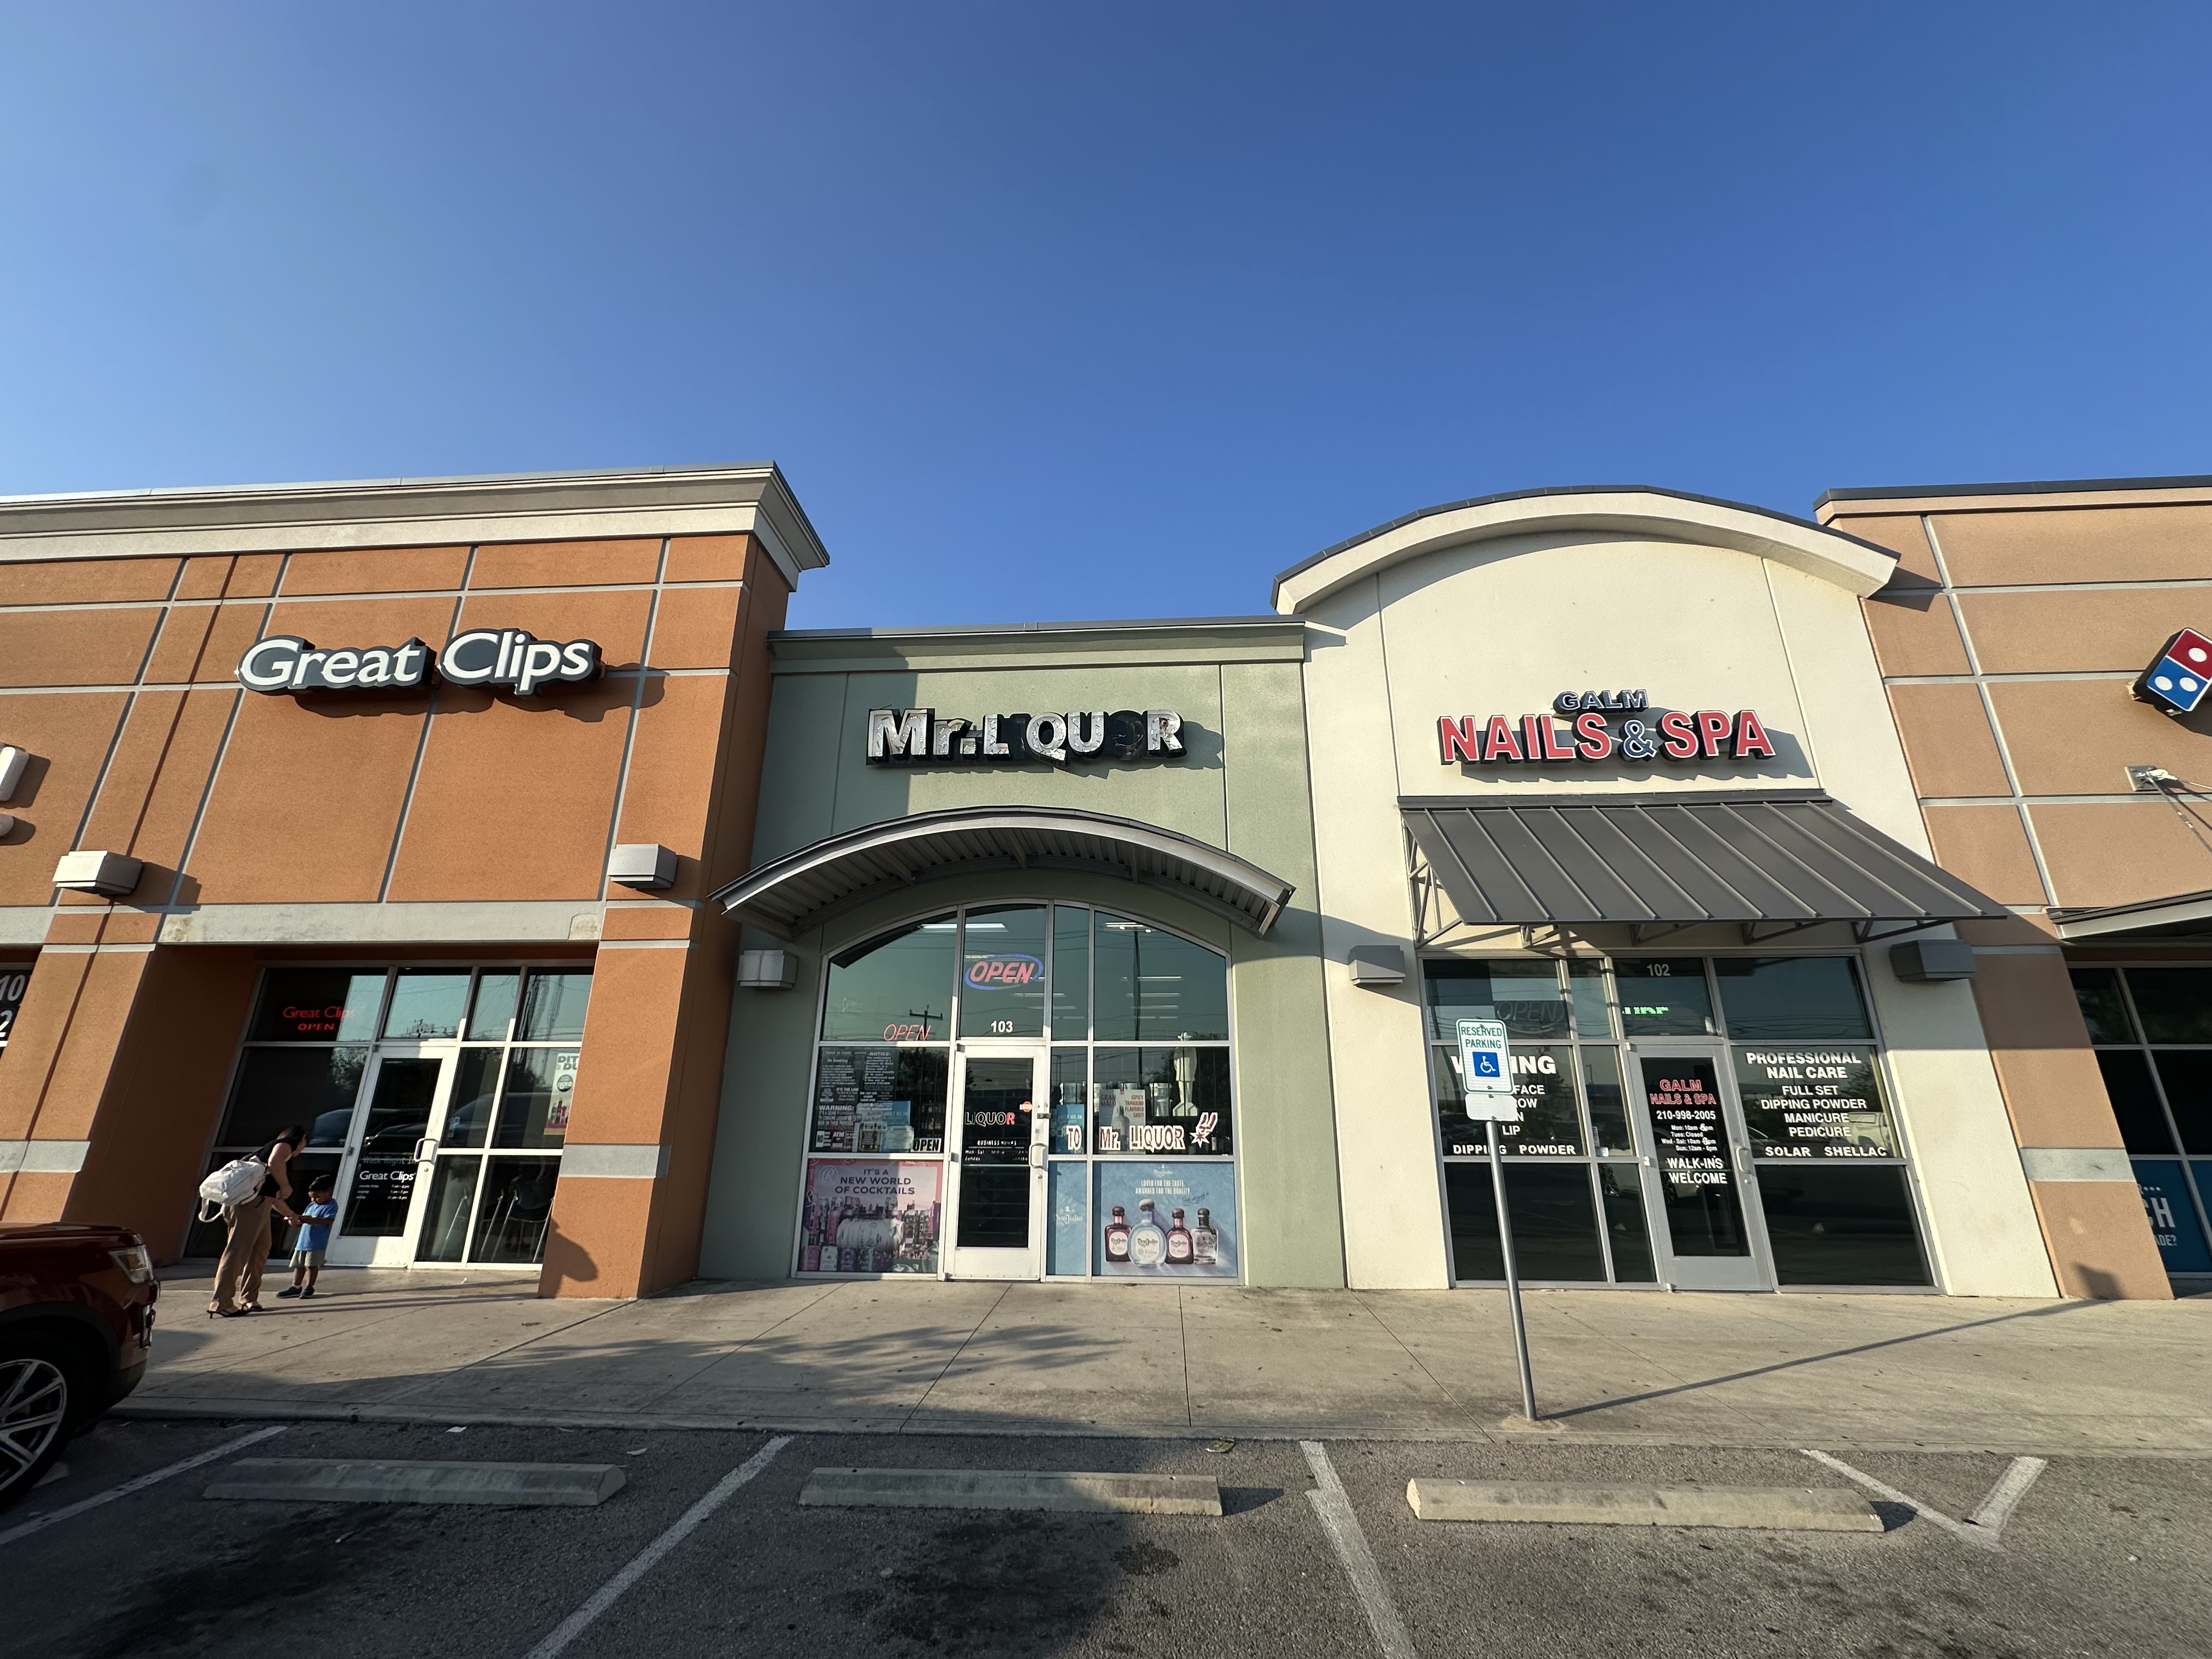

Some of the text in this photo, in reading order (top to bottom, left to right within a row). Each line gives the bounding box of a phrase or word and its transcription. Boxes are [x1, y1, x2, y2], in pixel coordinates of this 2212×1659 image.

[241, 631, 591, 691] Great Clips
[1556, 690, 1649, 711] GALM
[1440, 709, 1777, 762] NAILS & SPA
[970, 960, 1035, 984] OPEN
[1647, 963, 1671, 977] 102
[283, 1006, 357, 1019] Great Clips
[298, 1023, 335, 1031] OPEN
[991, 1020, 1014, 1032] 103
[1461, 1026, 1502, 1036] RESERVED
[883, 1024, 931, 1041] OPEN
[1465, 1039, 1502, 1049] PARKING
[1746, 1052, 1861, 1065] PROFESSIONAL
[1766, 1066, 1848, 1079] NAIL CARE
[1514, 1085, 1545, 1095] FACE
[1660, 1079, 1702, 1091] GALM
[1782, 1085, 1839, 1096] FULL SET
[1650, 1093, 1717, 1105] NAILS & SPA
[1761, 1099, 1867, 1109] DIPPING POWDER
[965, 1111, 1015, 1127] LIQUOR
[1656, 1110, 1716, 1120] 210-998-2005
[1784, 1113, 1850, 1123] MANICURE
[1502, 1125, 1521, 1135] LIP
[1788, 1127, 1852, 1137] PEDICURE
[1066, 1125, 1186, 1153] TO Mr. LIQUOR
[913, 1139, 940, 1152] OPEN
[1453, 1144, 1576, 1154] DIPPIG POWDER
[1765, 1147, 1887, 1156] SOLAR SHELLAC
[1667, 1158, 1723, 1169] WALK-INS
[360, 1170, 414, 1183] Great Clips
[870, 1177, 911, 1185] WORLD
[1668, 1172, 1728, 1184] WELCOME
[853, 1186, 916, 1195] COCKTAILS
